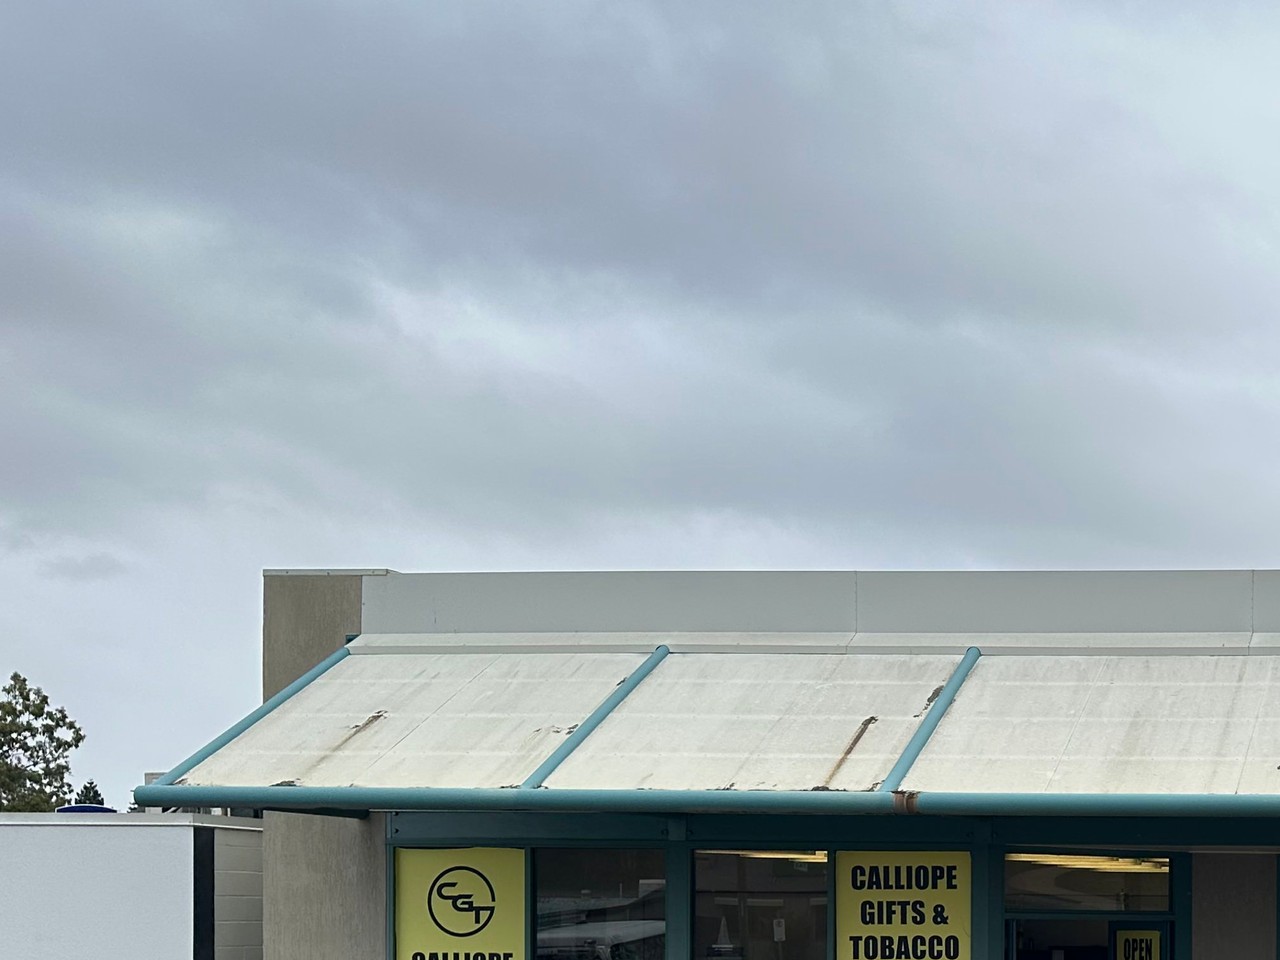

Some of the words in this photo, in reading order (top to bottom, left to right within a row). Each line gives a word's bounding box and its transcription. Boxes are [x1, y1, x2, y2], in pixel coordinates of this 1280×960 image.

[851, 864, 958, 891] CALLIOPE
[860, 899, 926, 926] GIFTS
[932, 904, 949, 926] &
[848, 934, 960, 960] TOBACCO
